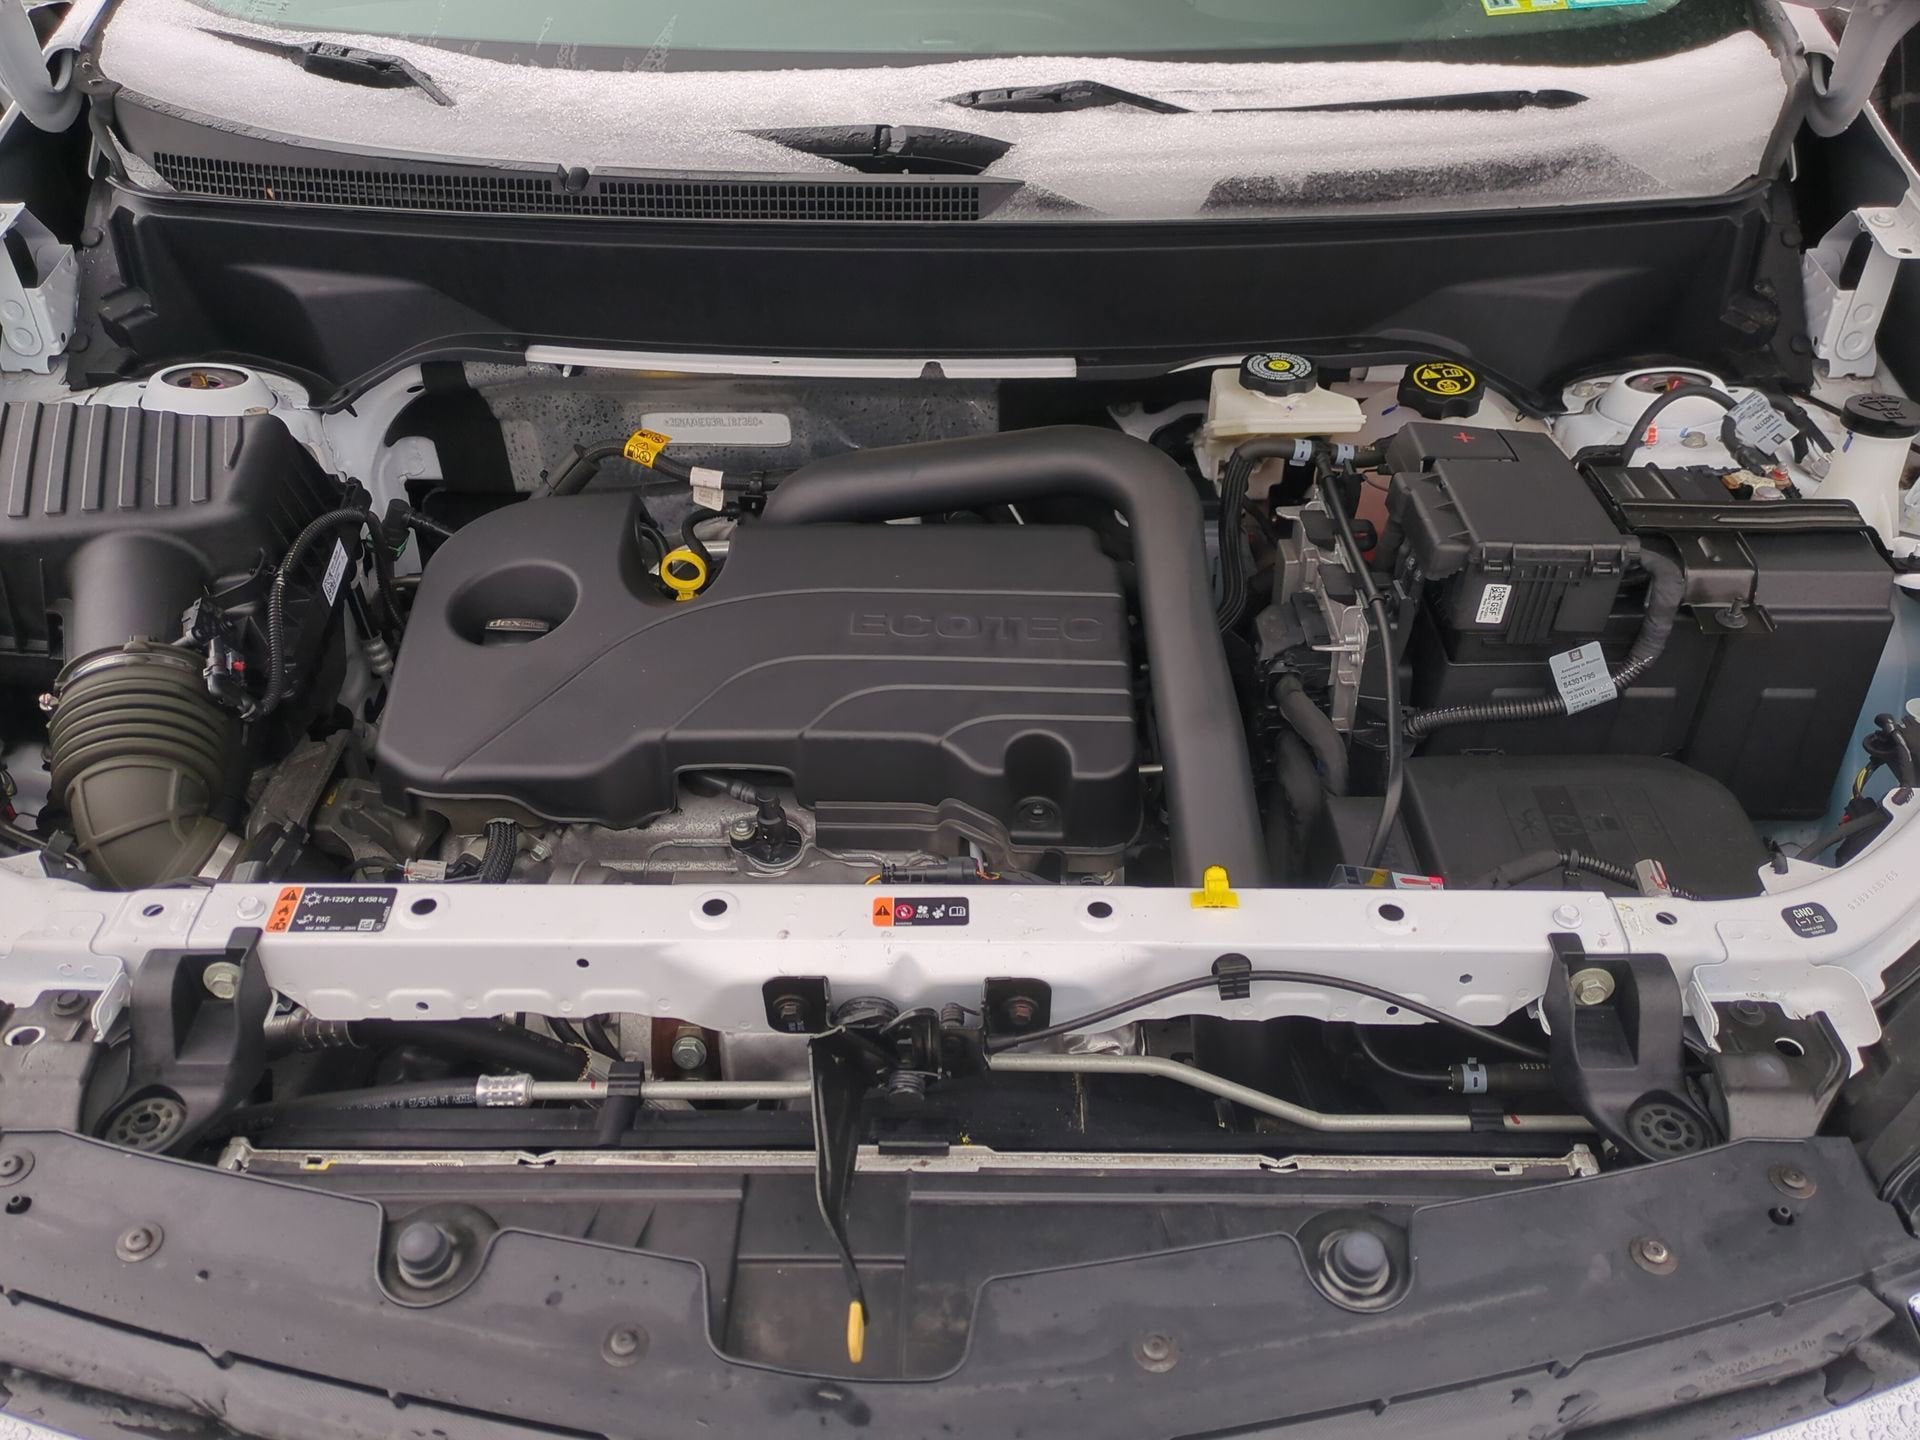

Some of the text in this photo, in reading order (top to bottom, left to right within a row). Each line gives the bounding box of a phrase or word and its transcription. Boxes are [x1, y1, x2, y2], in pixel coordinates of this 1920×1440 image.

[850, 612, 1104, 642] ECOTEC
[323, 896, 355, 904] R-1234yf
[1793, 907, 1814, 918] GND
[316, 915, 331, 923] PAG
